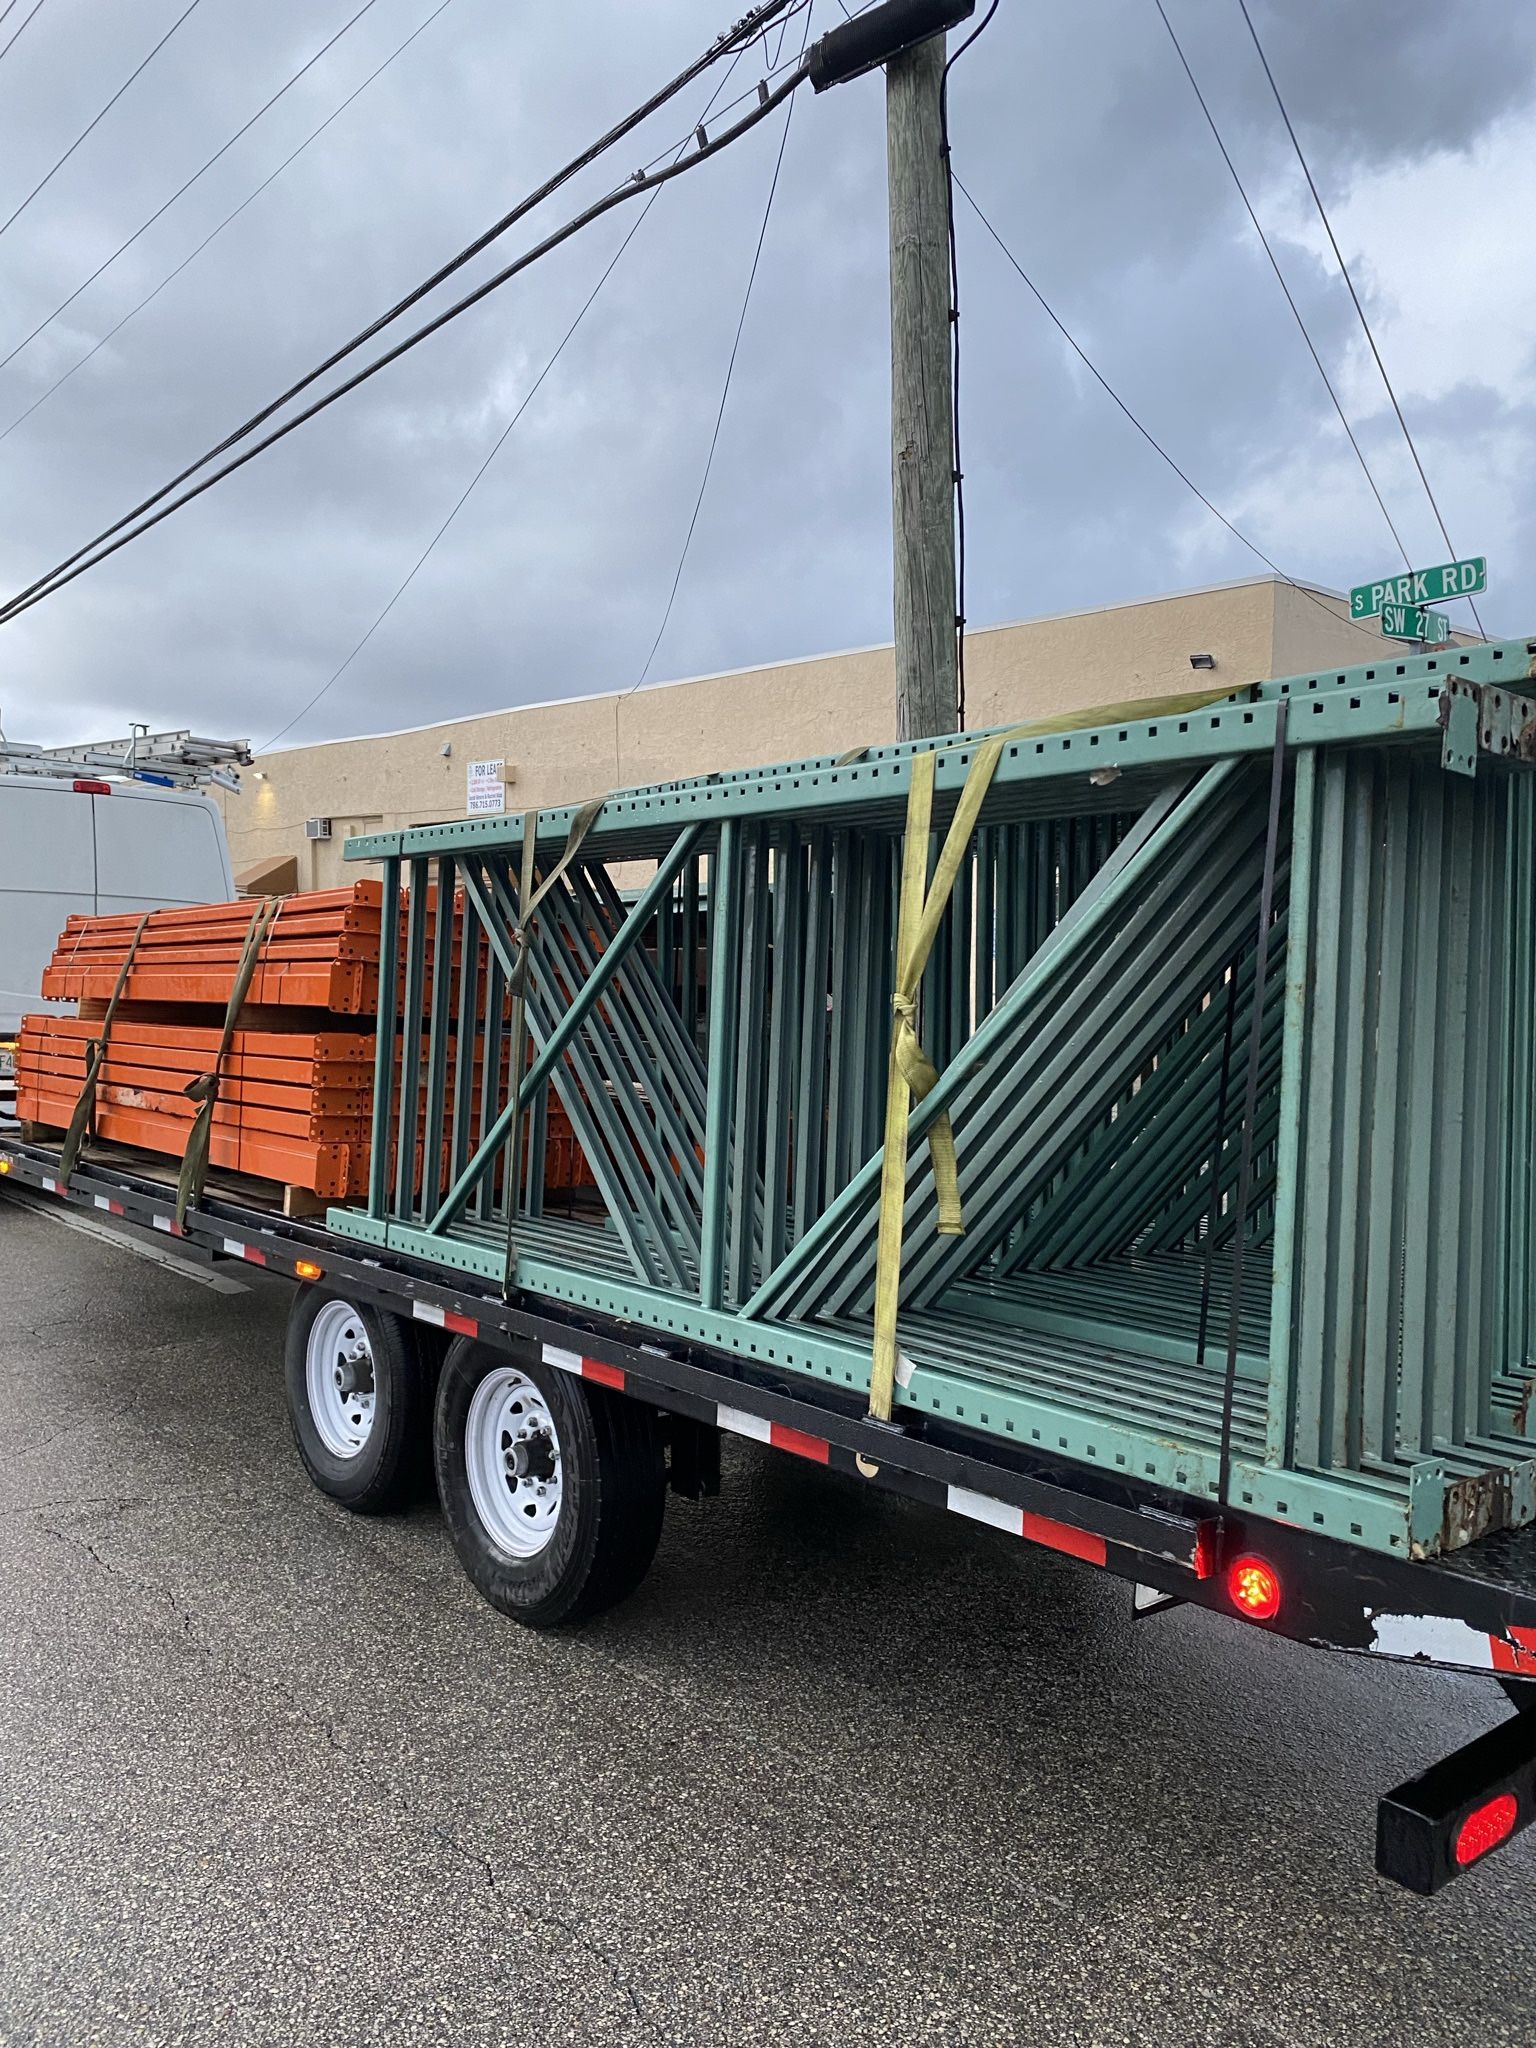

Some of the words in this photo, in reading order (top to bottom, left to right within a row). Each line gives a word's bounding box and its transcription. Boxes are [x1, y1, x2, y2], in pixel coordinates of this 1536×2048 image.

[1355, 594, 1363, 611] S
[1371, 573, 1429, 611] PARK
[1442, 564, 1477, 594] RD
[1385, 608, 1405, 633] SW
[1416, 612, 1429, 637] 27
[1437, 617, 1448, 642] ST
[475, 765, 486, 776] FOR
